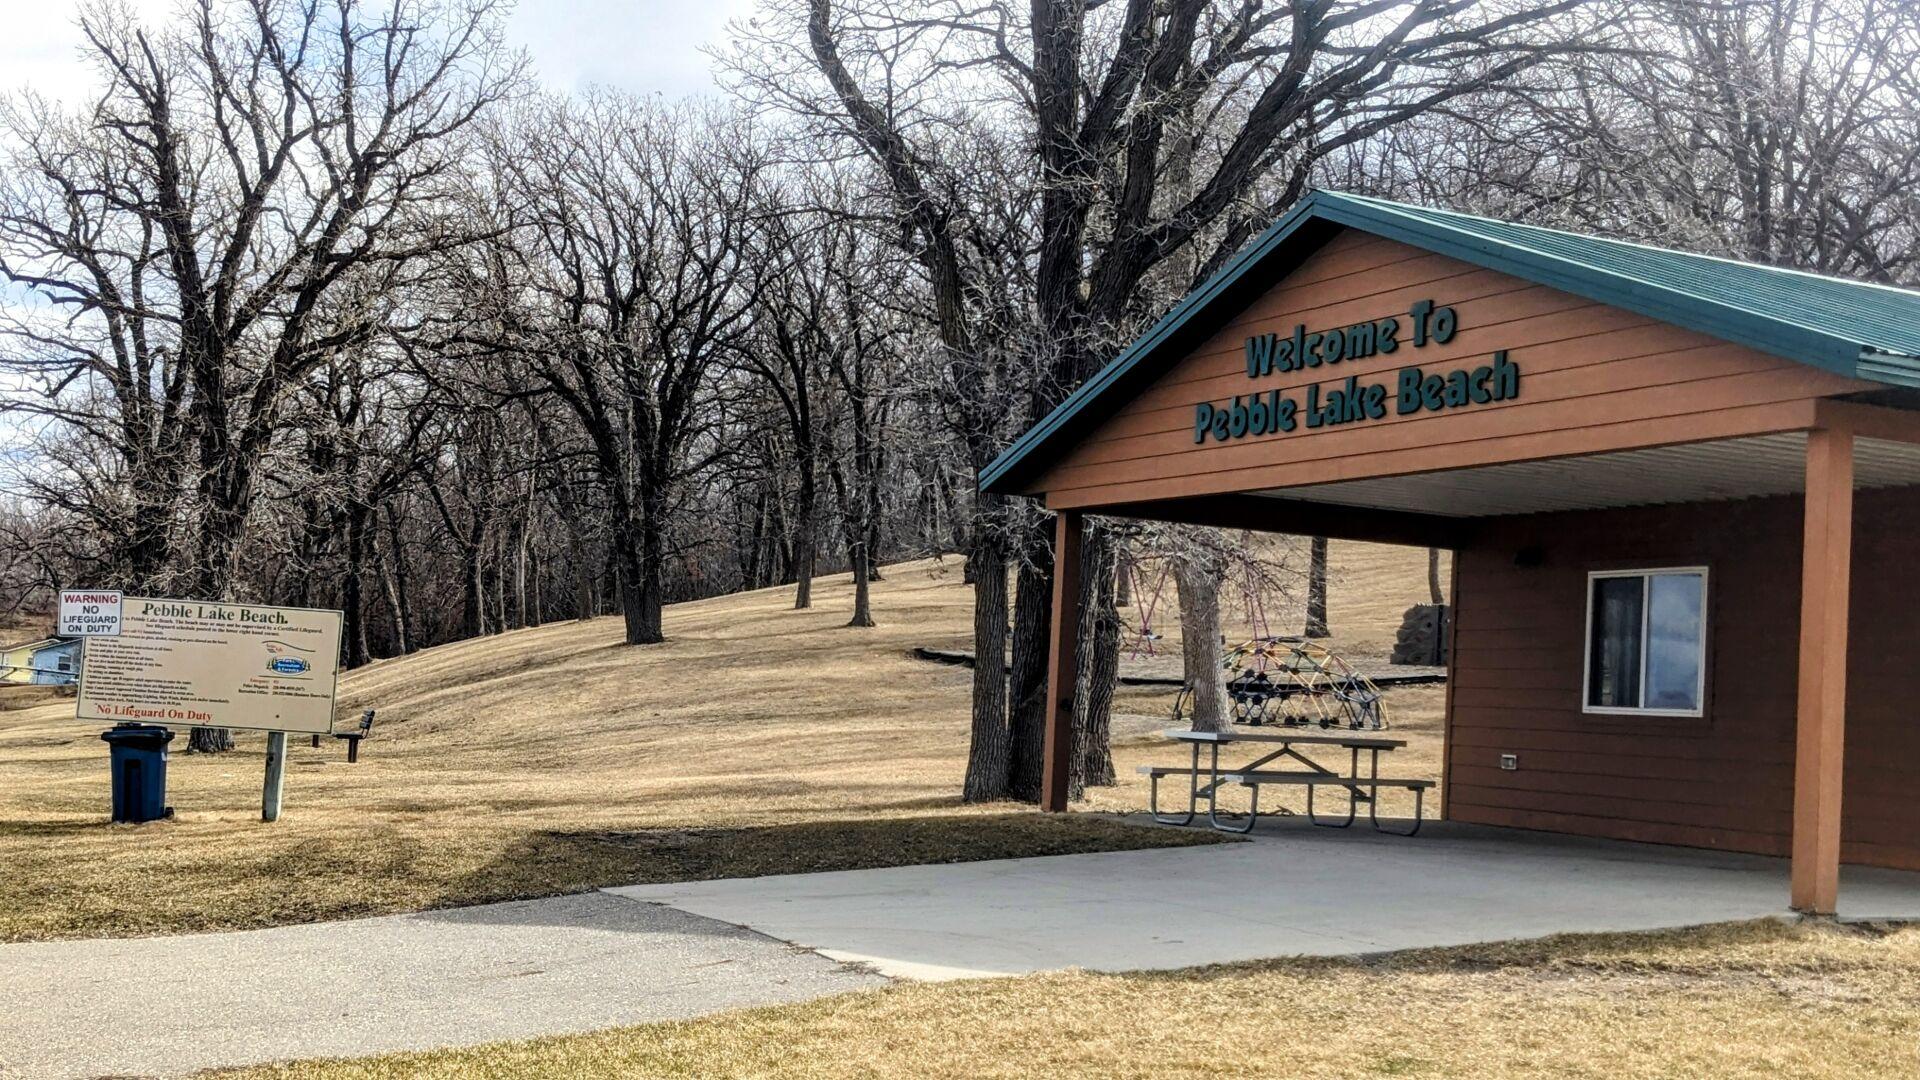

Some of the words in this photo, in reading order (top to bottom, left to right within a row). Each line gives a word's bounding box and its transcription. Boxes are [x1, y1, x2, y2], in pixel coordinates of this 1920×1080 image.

[1245, 318, 1399, 378] Welcome
[1409, 299, 1458, 347] To
[1194, 389, 1297, 444] Pebble
[1305, 375, 1387, 428] Lake
[1396, 349, 1520, 415] Beach
[64, 594, 118, 604] WARNING
[82, 605, 100, 615] NO
[144, 602, 192, 618] Pebble
[197, 605, 235, 621] Lake
[240, 608, 289, 624] Beach.
[63, 615, 118, 624] LIFEGUARD
[68, 624, 82, 633] ON
[87, 624, 112, 633] DUTY
[96, 704, 111, 714] No
[114, 705, 165, 719] Lifeguard
[168, 709, 184, 719] On
[187, 710, 213, 723] Duty
